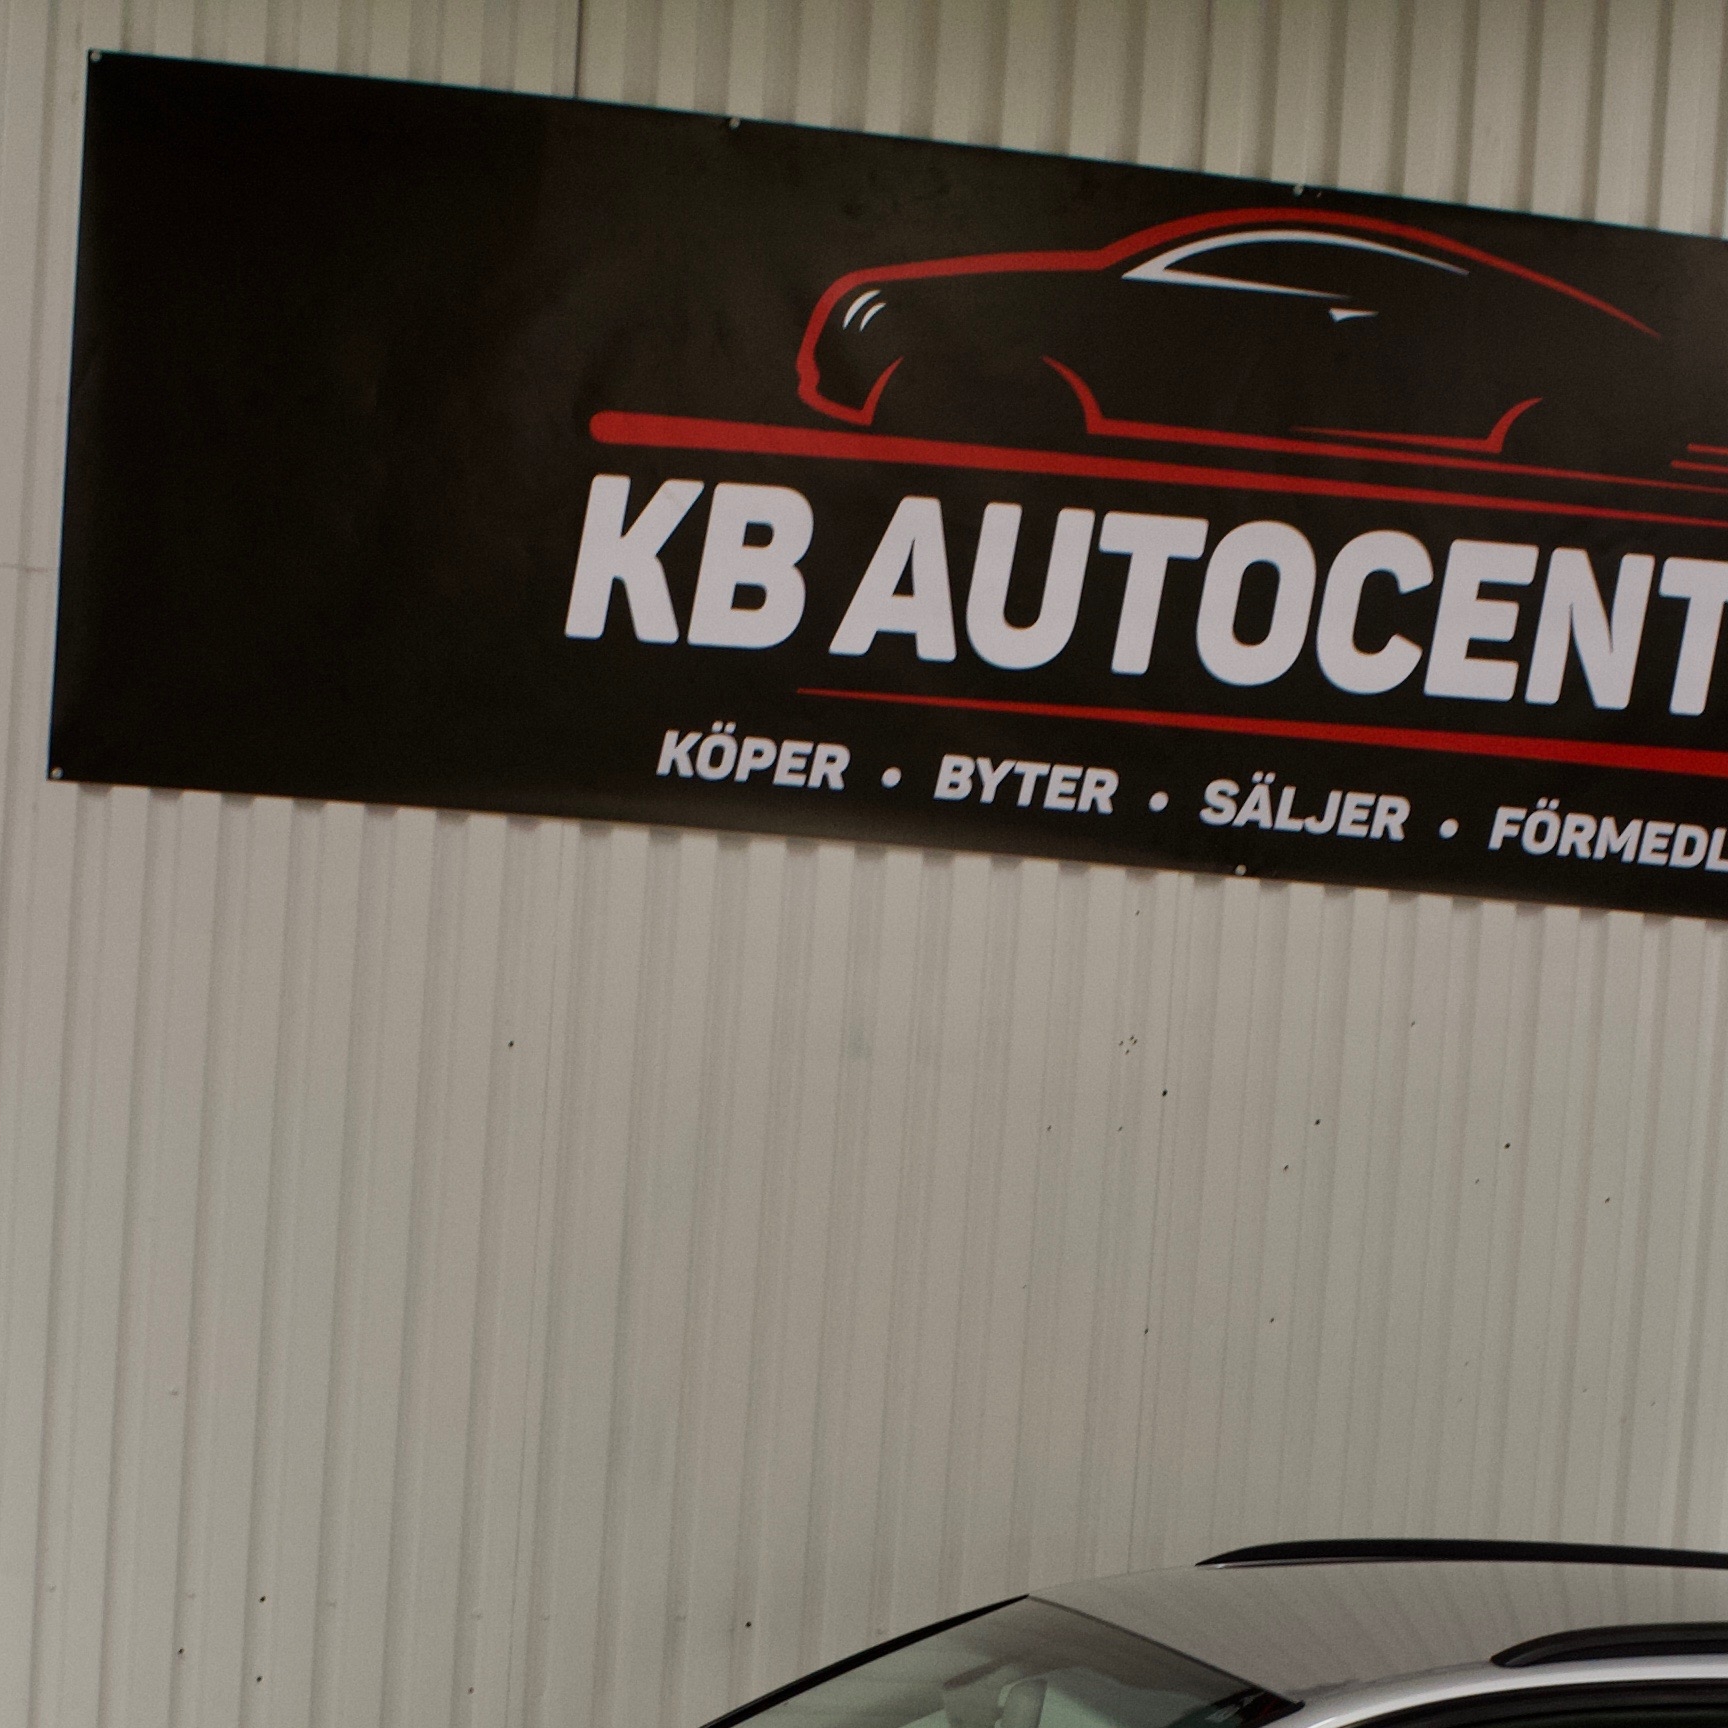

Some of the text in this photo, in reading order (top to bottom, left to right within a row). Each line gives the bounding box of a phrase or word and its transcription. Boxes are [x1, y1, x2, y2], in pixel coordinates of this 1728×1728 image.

[565, 474, 814, 648] KB
[656, 721, 851, 790] KÖPER
[934, 754, 1119, 813] BYTER
[1200, 772, 1410, 840] SÄLJER
